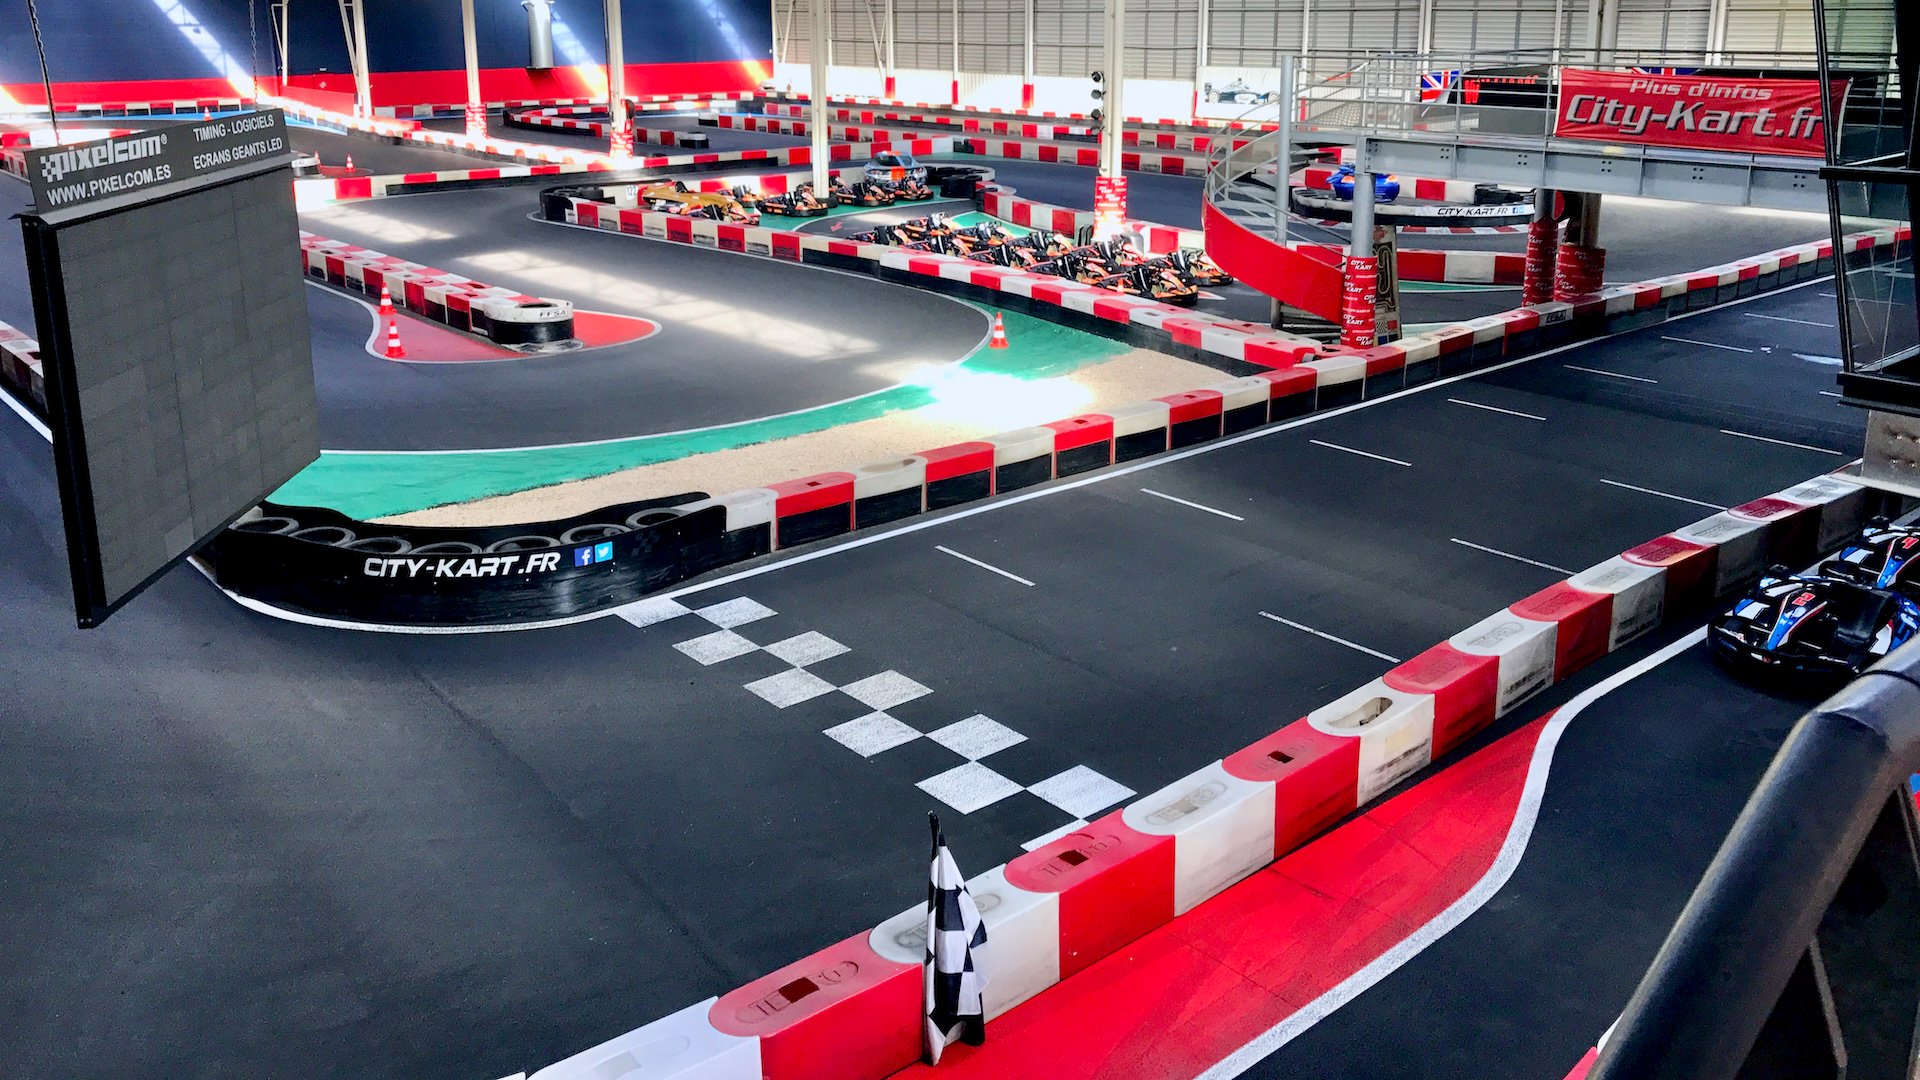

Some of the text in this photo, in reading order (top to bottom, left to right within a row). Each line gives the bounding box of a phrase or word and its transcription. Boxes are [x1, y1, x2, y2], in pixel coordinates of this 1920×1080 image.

[1629, 79, 1681, 97] Plus
[193, 122, 227, 143] TIMING
[231, 114, 275, 135] LOGICIELS
[1565, 93, 1823, 140] City-Kart.fr
[193, 137, 284, 171] ECRANS GEANTS LED
[47, 164, 172, 206] WWW.PIXELCOM.ES
[363, 551, 562, 579] CITY-KART.FR
[1791, 592, 1816, 607] 2
